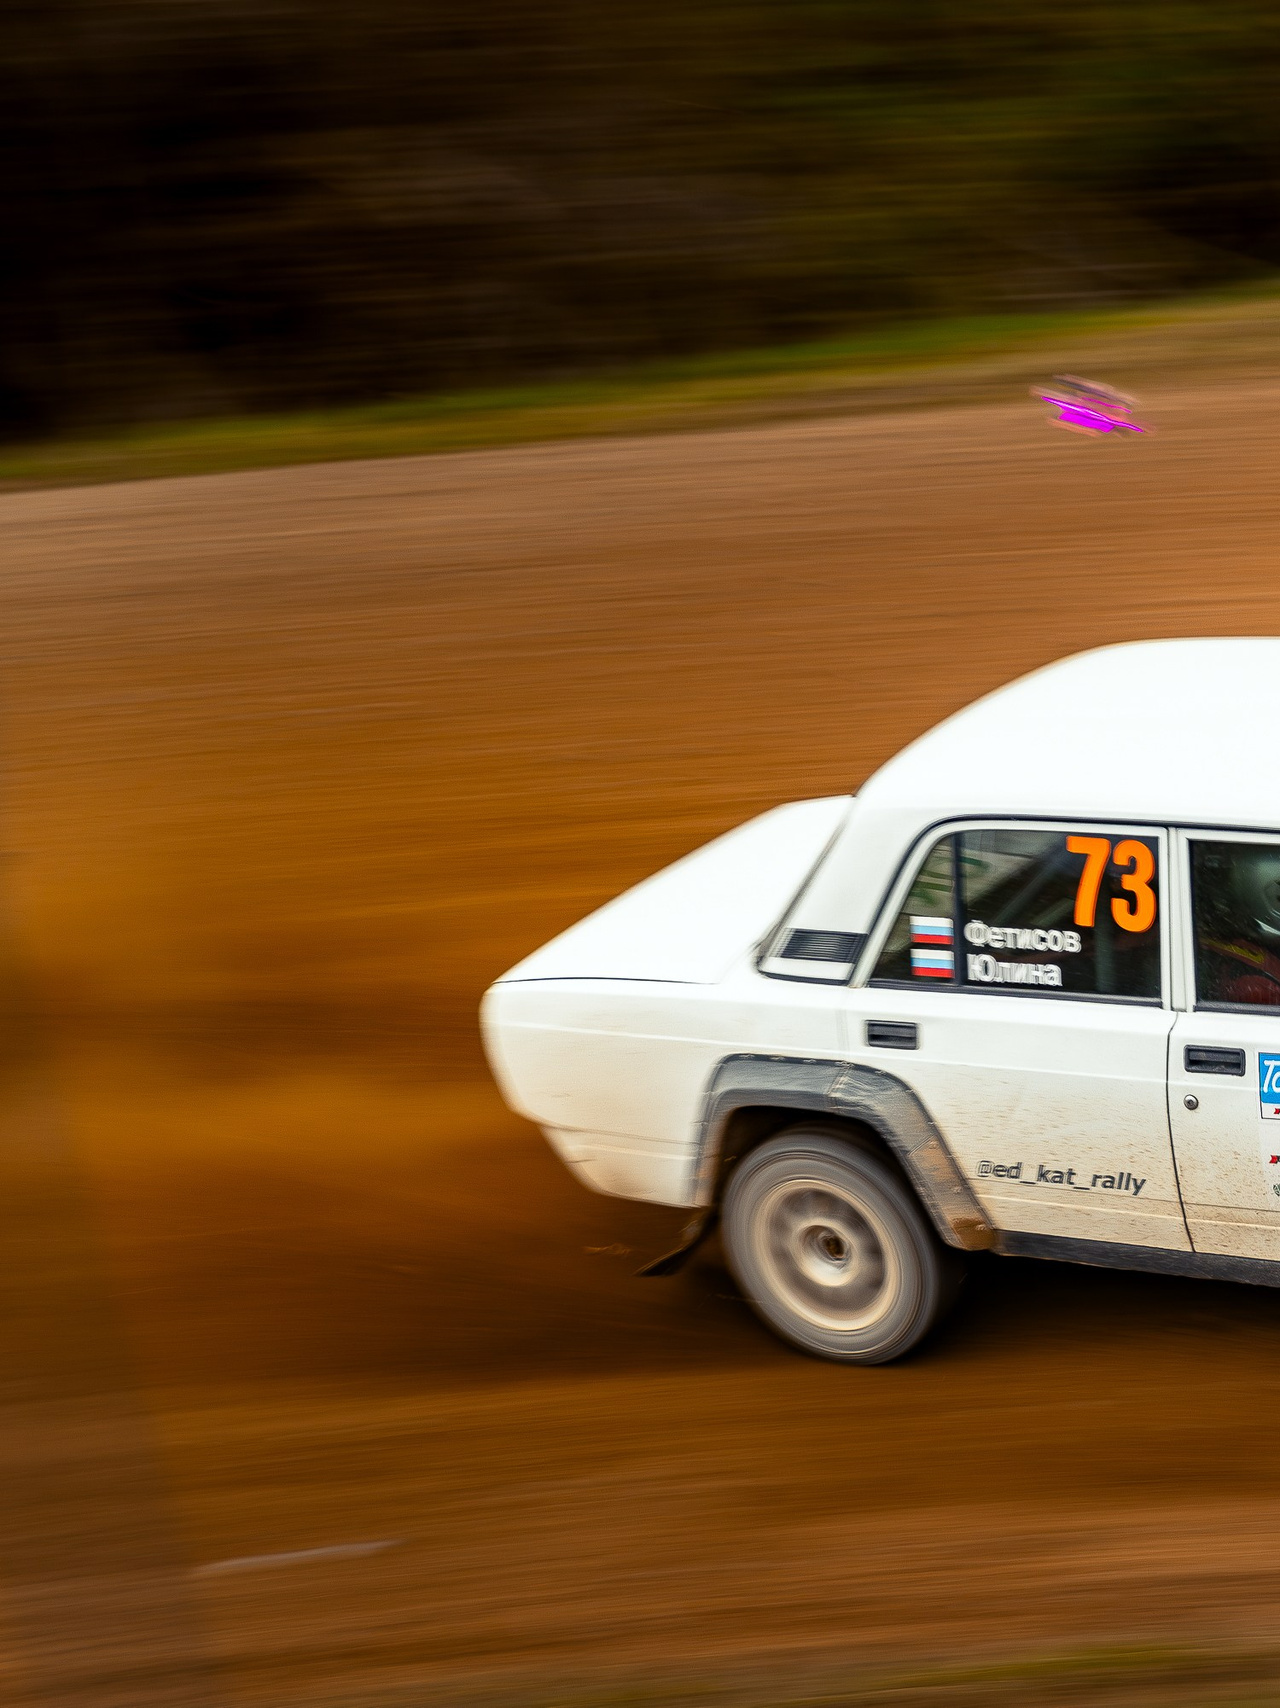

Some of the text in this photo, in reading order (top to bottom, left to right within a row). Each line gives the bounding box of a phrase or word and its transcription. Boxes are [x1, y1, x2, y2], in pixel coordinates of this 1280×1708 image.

[1065, 835, 1157, 932] 73
[963, 919, 1082, 953] Фетисов
[966, 953, 1063, 987] Юлина
[977, 1160, 1147, 1196] @ed_kat_rally
